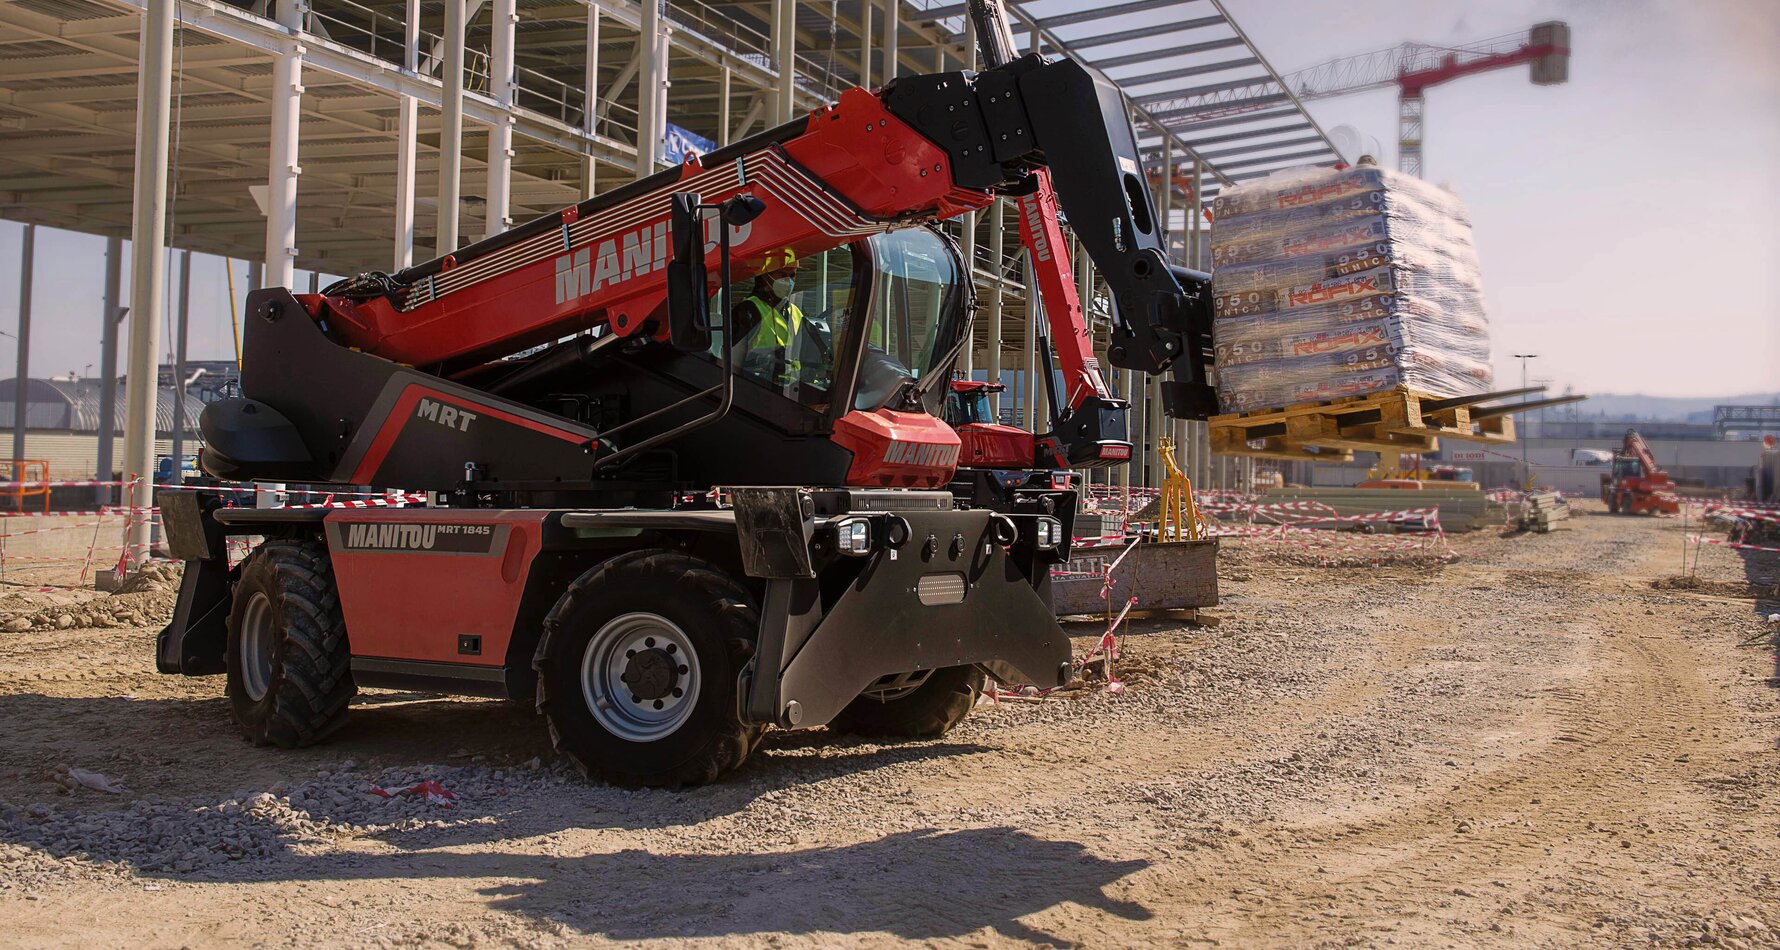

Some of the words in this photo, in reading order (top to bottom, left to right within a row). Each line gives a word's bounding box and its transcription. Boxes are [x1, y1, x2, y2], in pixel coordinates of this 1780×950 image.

[1339, 244, 1388, 266] 950
[1216, 292, 1260, 310] 950
[1216, 304, 1262, 318] UNICA
[1345, 295, 1393, 316] 950
[417, 398, 477, 432] MRT
[883, 440, 960, 467] MANITOU
[347, 524, 437, 549] MANITOU
[437, 525, 461, 534] MRT
[463, 526, 490, 535] 1845
